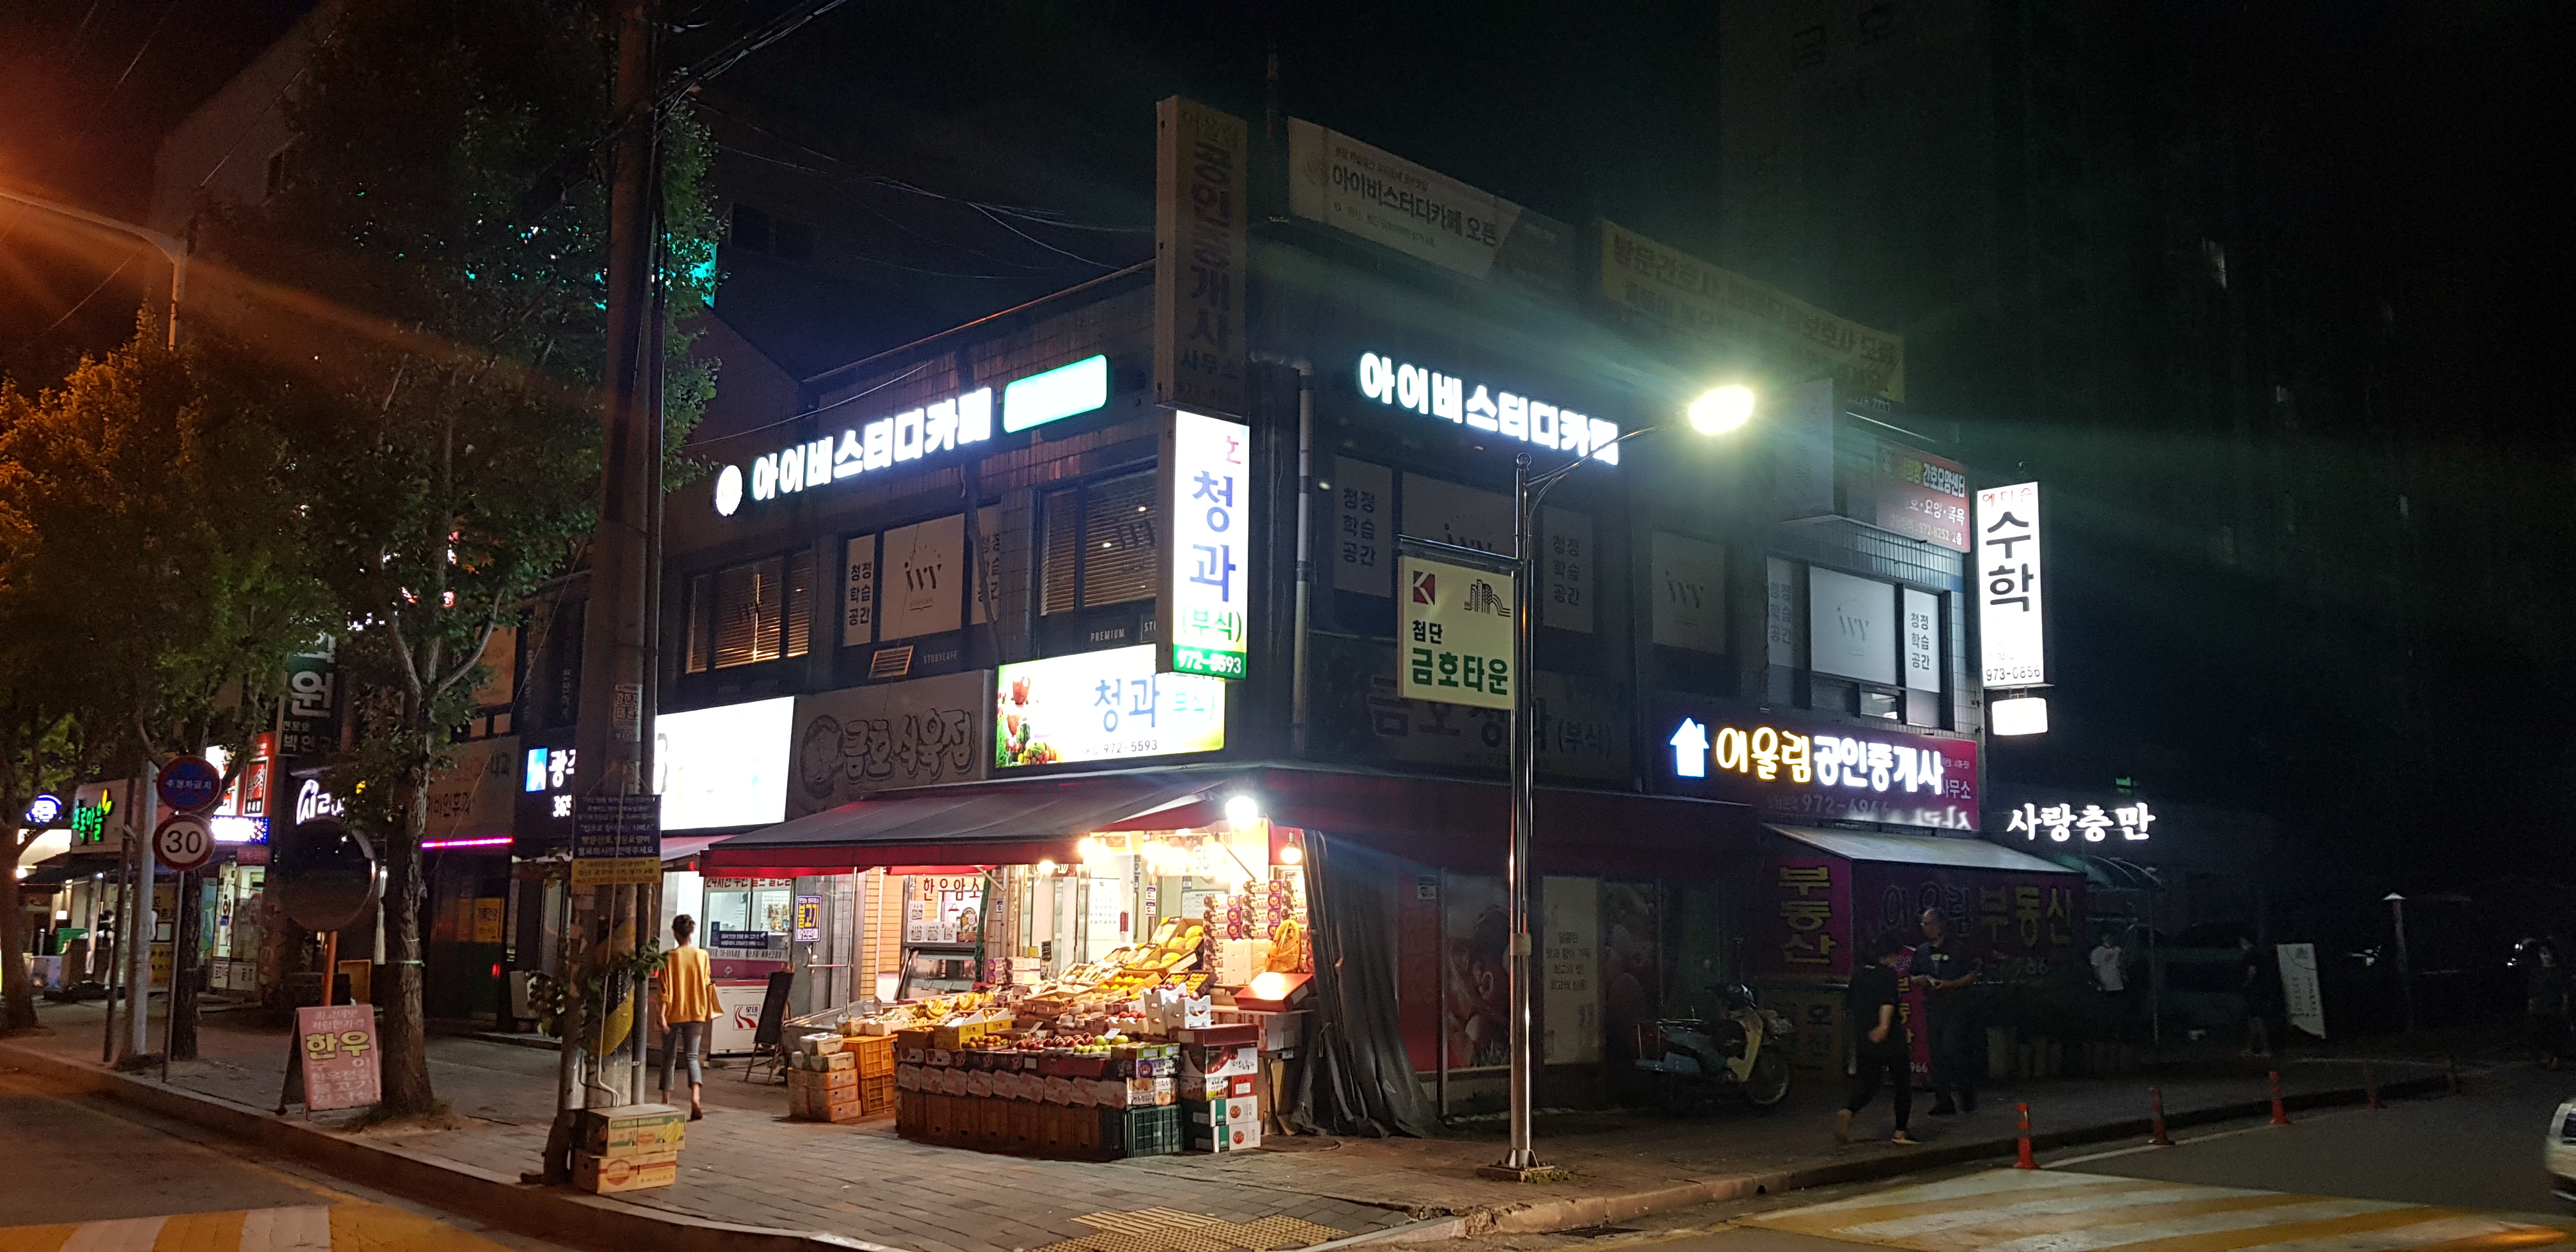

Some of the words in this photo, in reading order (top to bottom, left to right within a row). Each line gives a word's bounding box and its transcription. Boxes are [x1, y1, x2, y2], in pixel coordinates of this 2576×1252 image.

[1333, 164, 1462, 237] 아이비스터디카페
[1467, 217, 1498, 247] 오픈
[1190, 139, 1233, 353] 공인중개사
[1360, 351, 1618, 466] 아이비스터디카페
[751, 386, 993, 502] 아이비스터디카페
[1923, 462, 1966, 498] 간호요양센터
[1343, 487, 1376, 513] 청정
[1190, 470, 1237, 603] 청과
[1343, 515, 1376, 540] 학습
[1342, 541, 1376, 567] 공간
[1553, 534, 1580, 557] 청정
[851, 561, 873, 582] 청정
[1985, 510, 2034, 613] 수학
[850, 584, 871, 604] 학습
[1553, 584, 1580, 607] 공간
[848, 607, 870, 626] 공간
[1181, 606, 1242, 643] (부식)
[1910, 611, 1929, 630] 청정
[1090, 628, 1125, 642] PREMIUM
[1412, 620, 1443, 645] 첨단
[1910, 632, 1929, 651] 학습
[923, 650, 958, 664] STUDYCAFE
[1177, 648, 1242, 675] 972-5593
[1910, 652, 1930, 671] 공간
[1412, 647, 1508, 696] 금호타운
[1986, 665, 2041, 682] 973-0856
[1094, 674, 1161, 733] 청과
[1103, 739, 1158, 754] 972-5593
[1557, 719, 1613, 760] (부식)
[1714, 726, 1813, 784] 어울림
[1813, 734, 1945, 796] 공인중개사
[2006, 801, 2157, 843] 사랑충만
[165, 830, 202, 854] 30
[923, 877, 981, 903] 한우암소
[797, 904, 820, 929] 불고기
[1779, 866, 1837, 965] 부동산
[1979, 884, 2074, 948] 부동산
[797, 928, 818, 940] 할인판매
[305, 1030, 371, 1061] 한우
